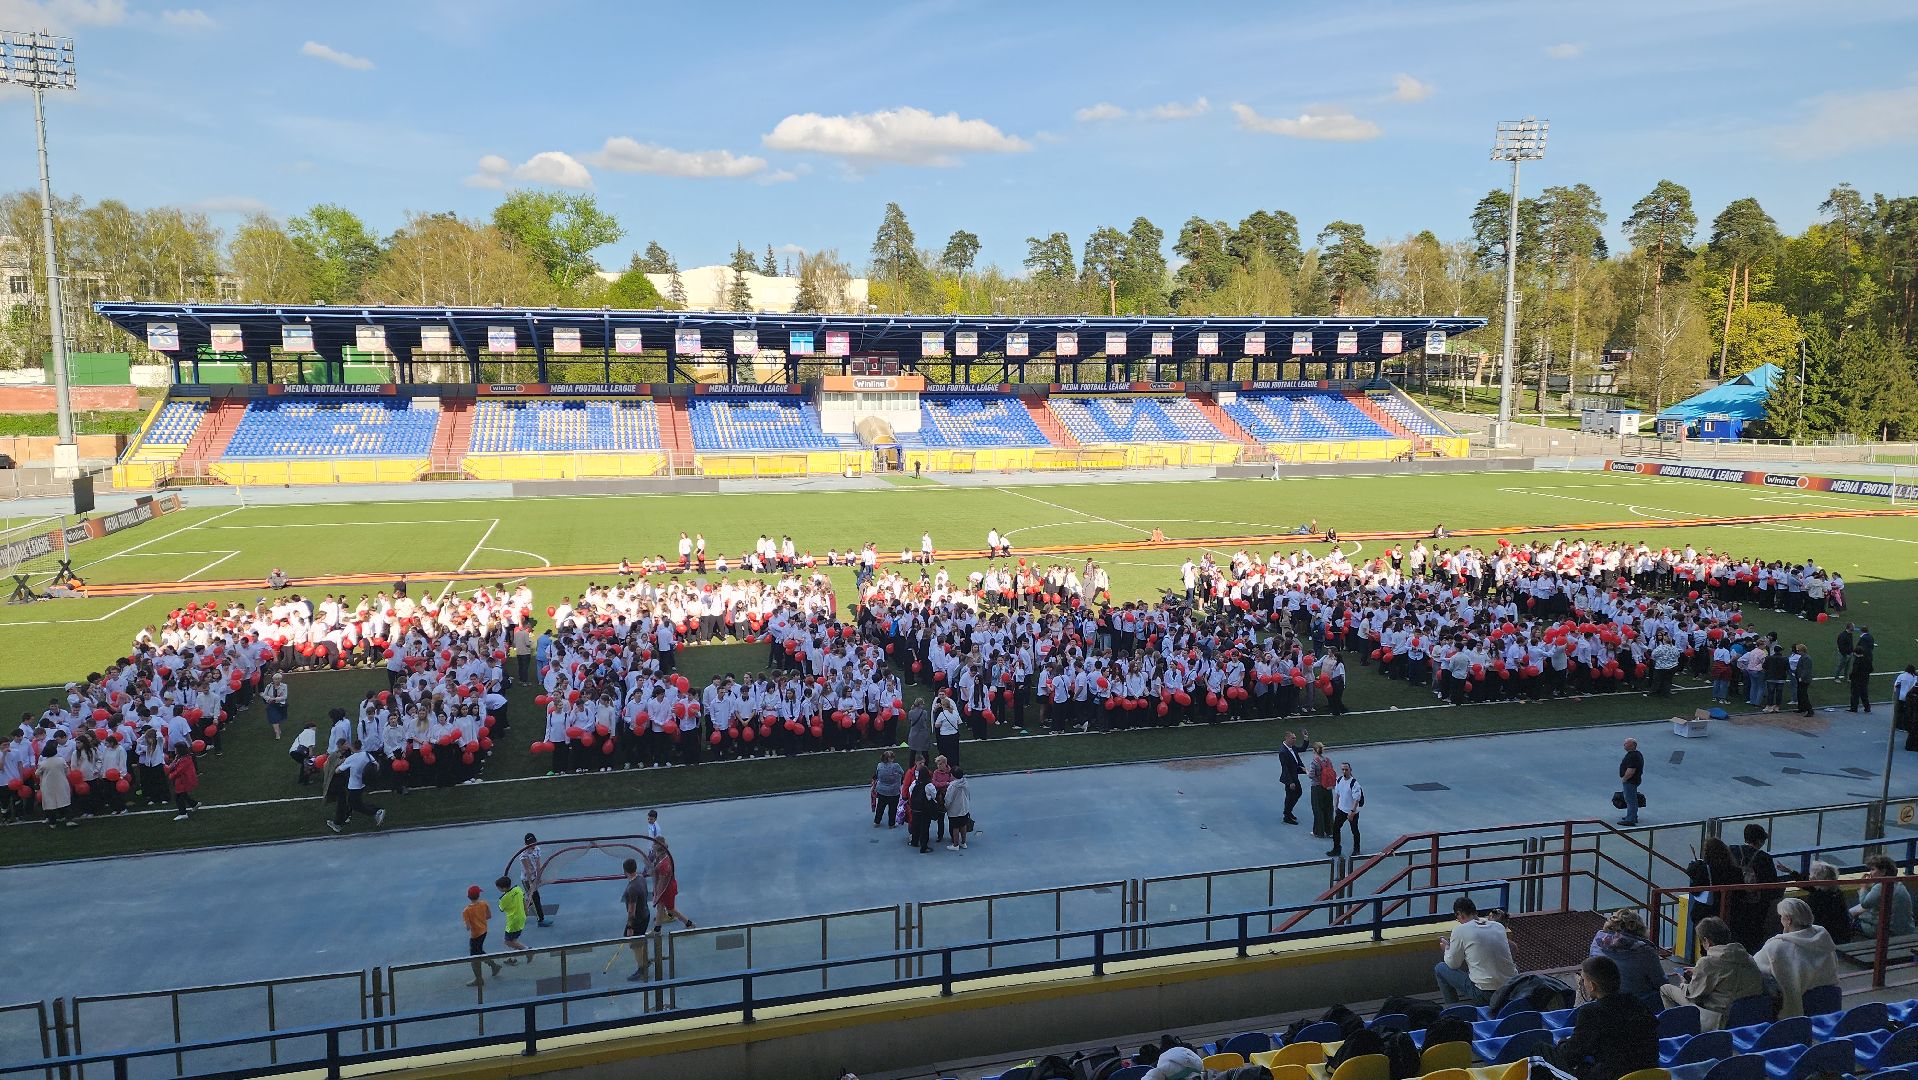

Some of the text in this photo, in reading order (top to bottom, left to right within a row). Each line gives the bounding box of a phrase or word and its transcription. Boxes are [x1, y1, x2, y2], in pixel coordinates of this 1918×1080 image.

[550, 384, 636, 393] MEDIA FOOTBALL LEAGUE
[709, 384, 788, 393] MEDIA FOOTBALL LEAGUE
[856, 380, 885, 388] Winline
[926, 384, 946, 392] MEDIA
[946, 384, 975, 392] FOOTBALL
[1061, 383, 1080, 391] MEDIA
[1109, 382, 1130, 390] LEAGUE
[284, 385, 380, 393] MEDIA FOOTBALL LEAGUE
[1612, 463, 1635, 471] Winline
[1659, 465, 1745, 482] MEDIA FOOTBALL LEAGUE
[1767, 475, 1796, 486] Winline
[1830, 480, 1860, 493] MEDIA
